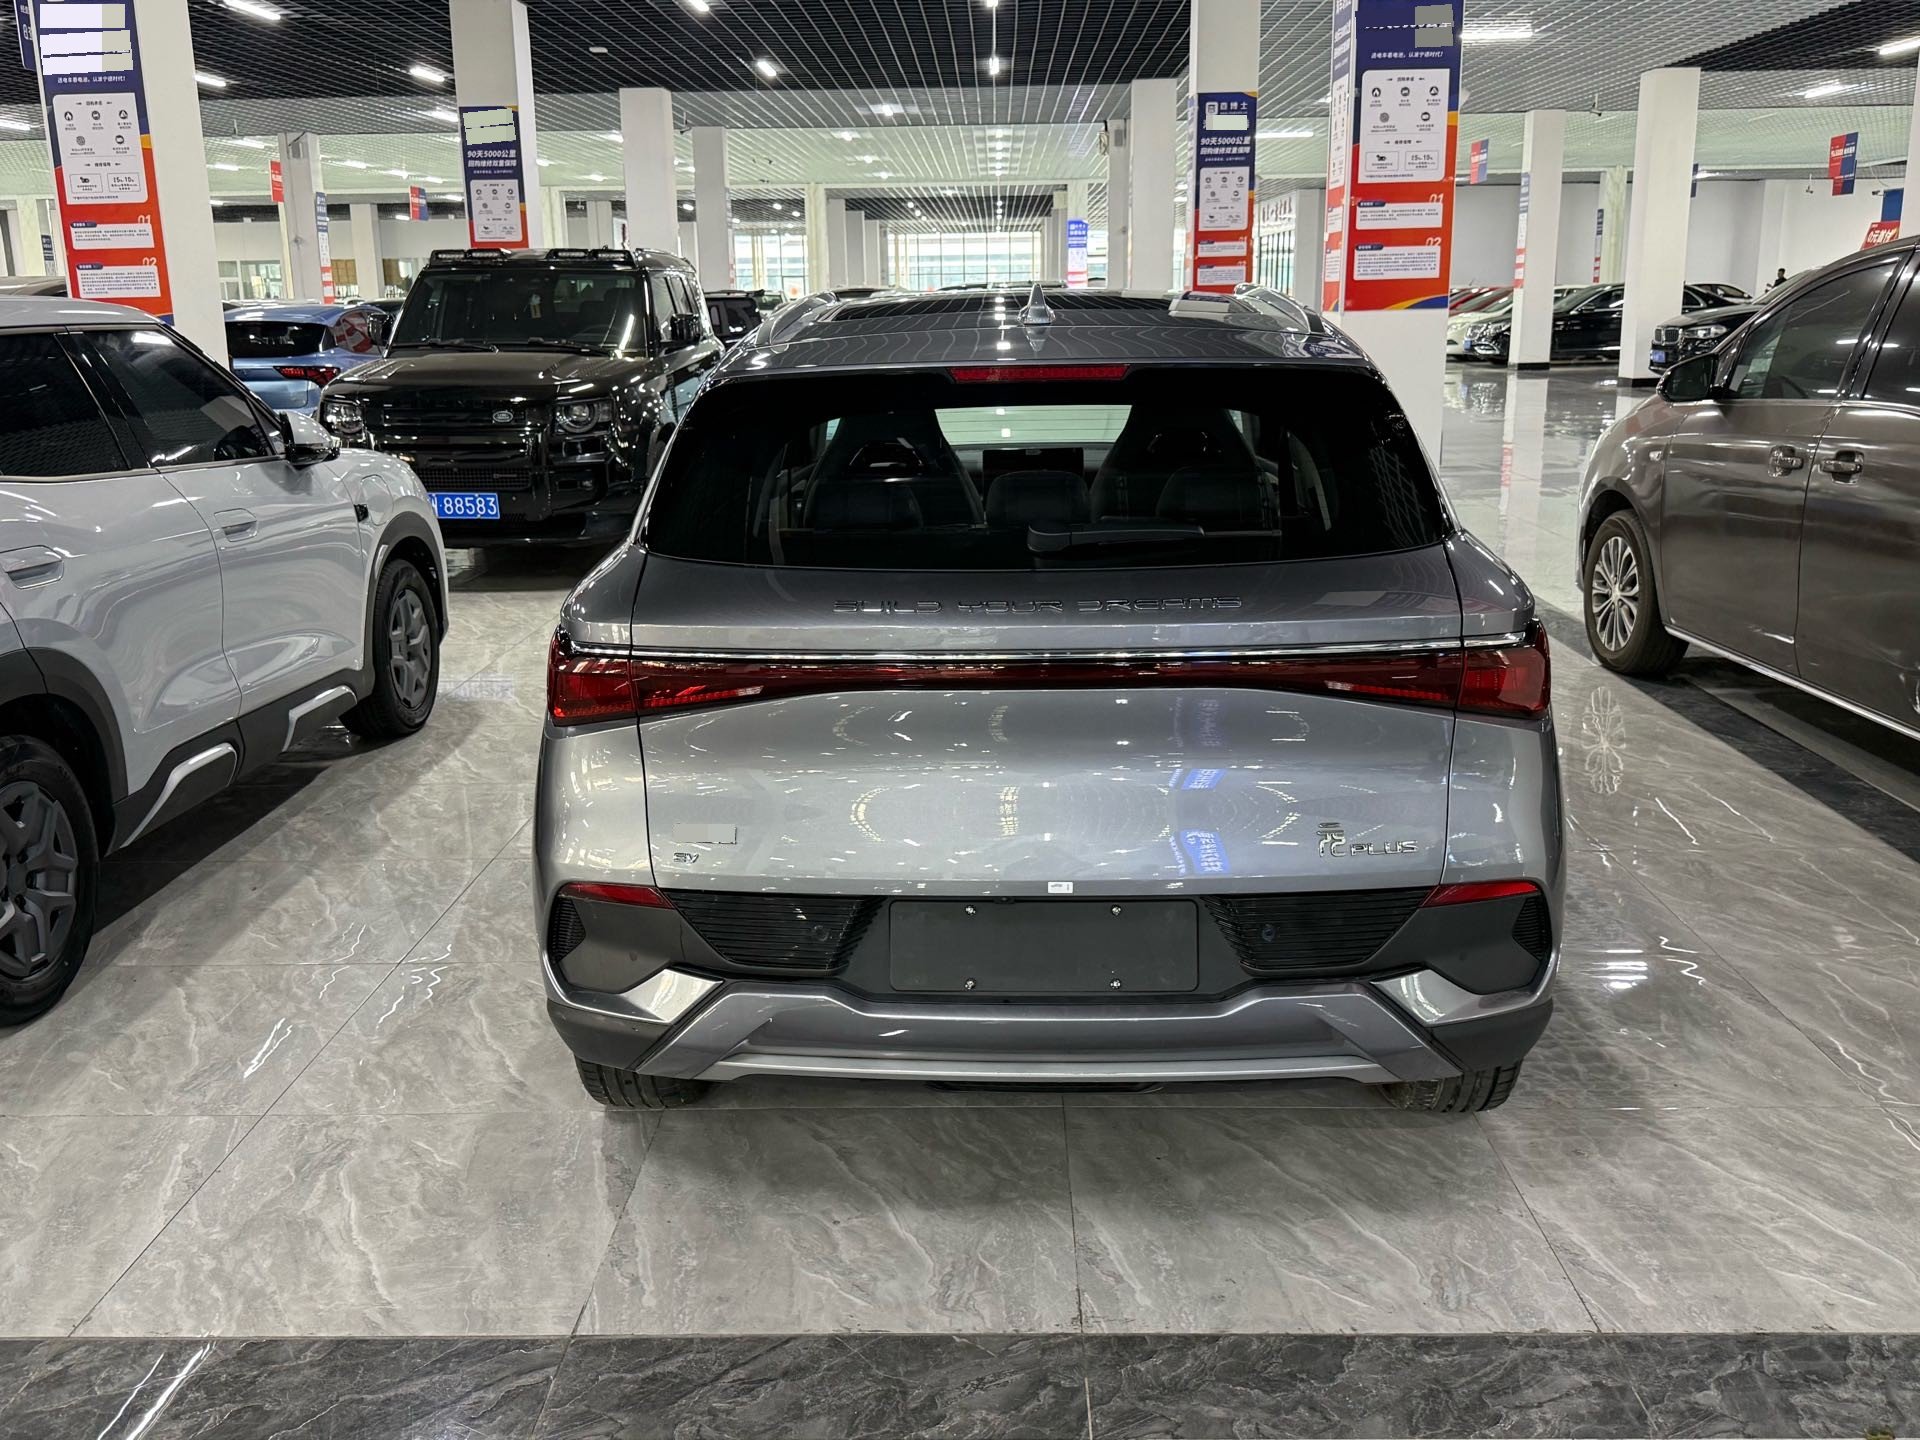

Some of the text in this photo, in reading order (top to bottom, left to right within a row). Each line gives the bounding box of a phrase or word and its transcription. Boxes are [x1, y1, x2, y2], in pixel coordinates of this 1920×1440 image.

[833, 597, 1242, 614] BUILD YOUR DREAMS
[1350, 841, 1419, 856] PLUS
